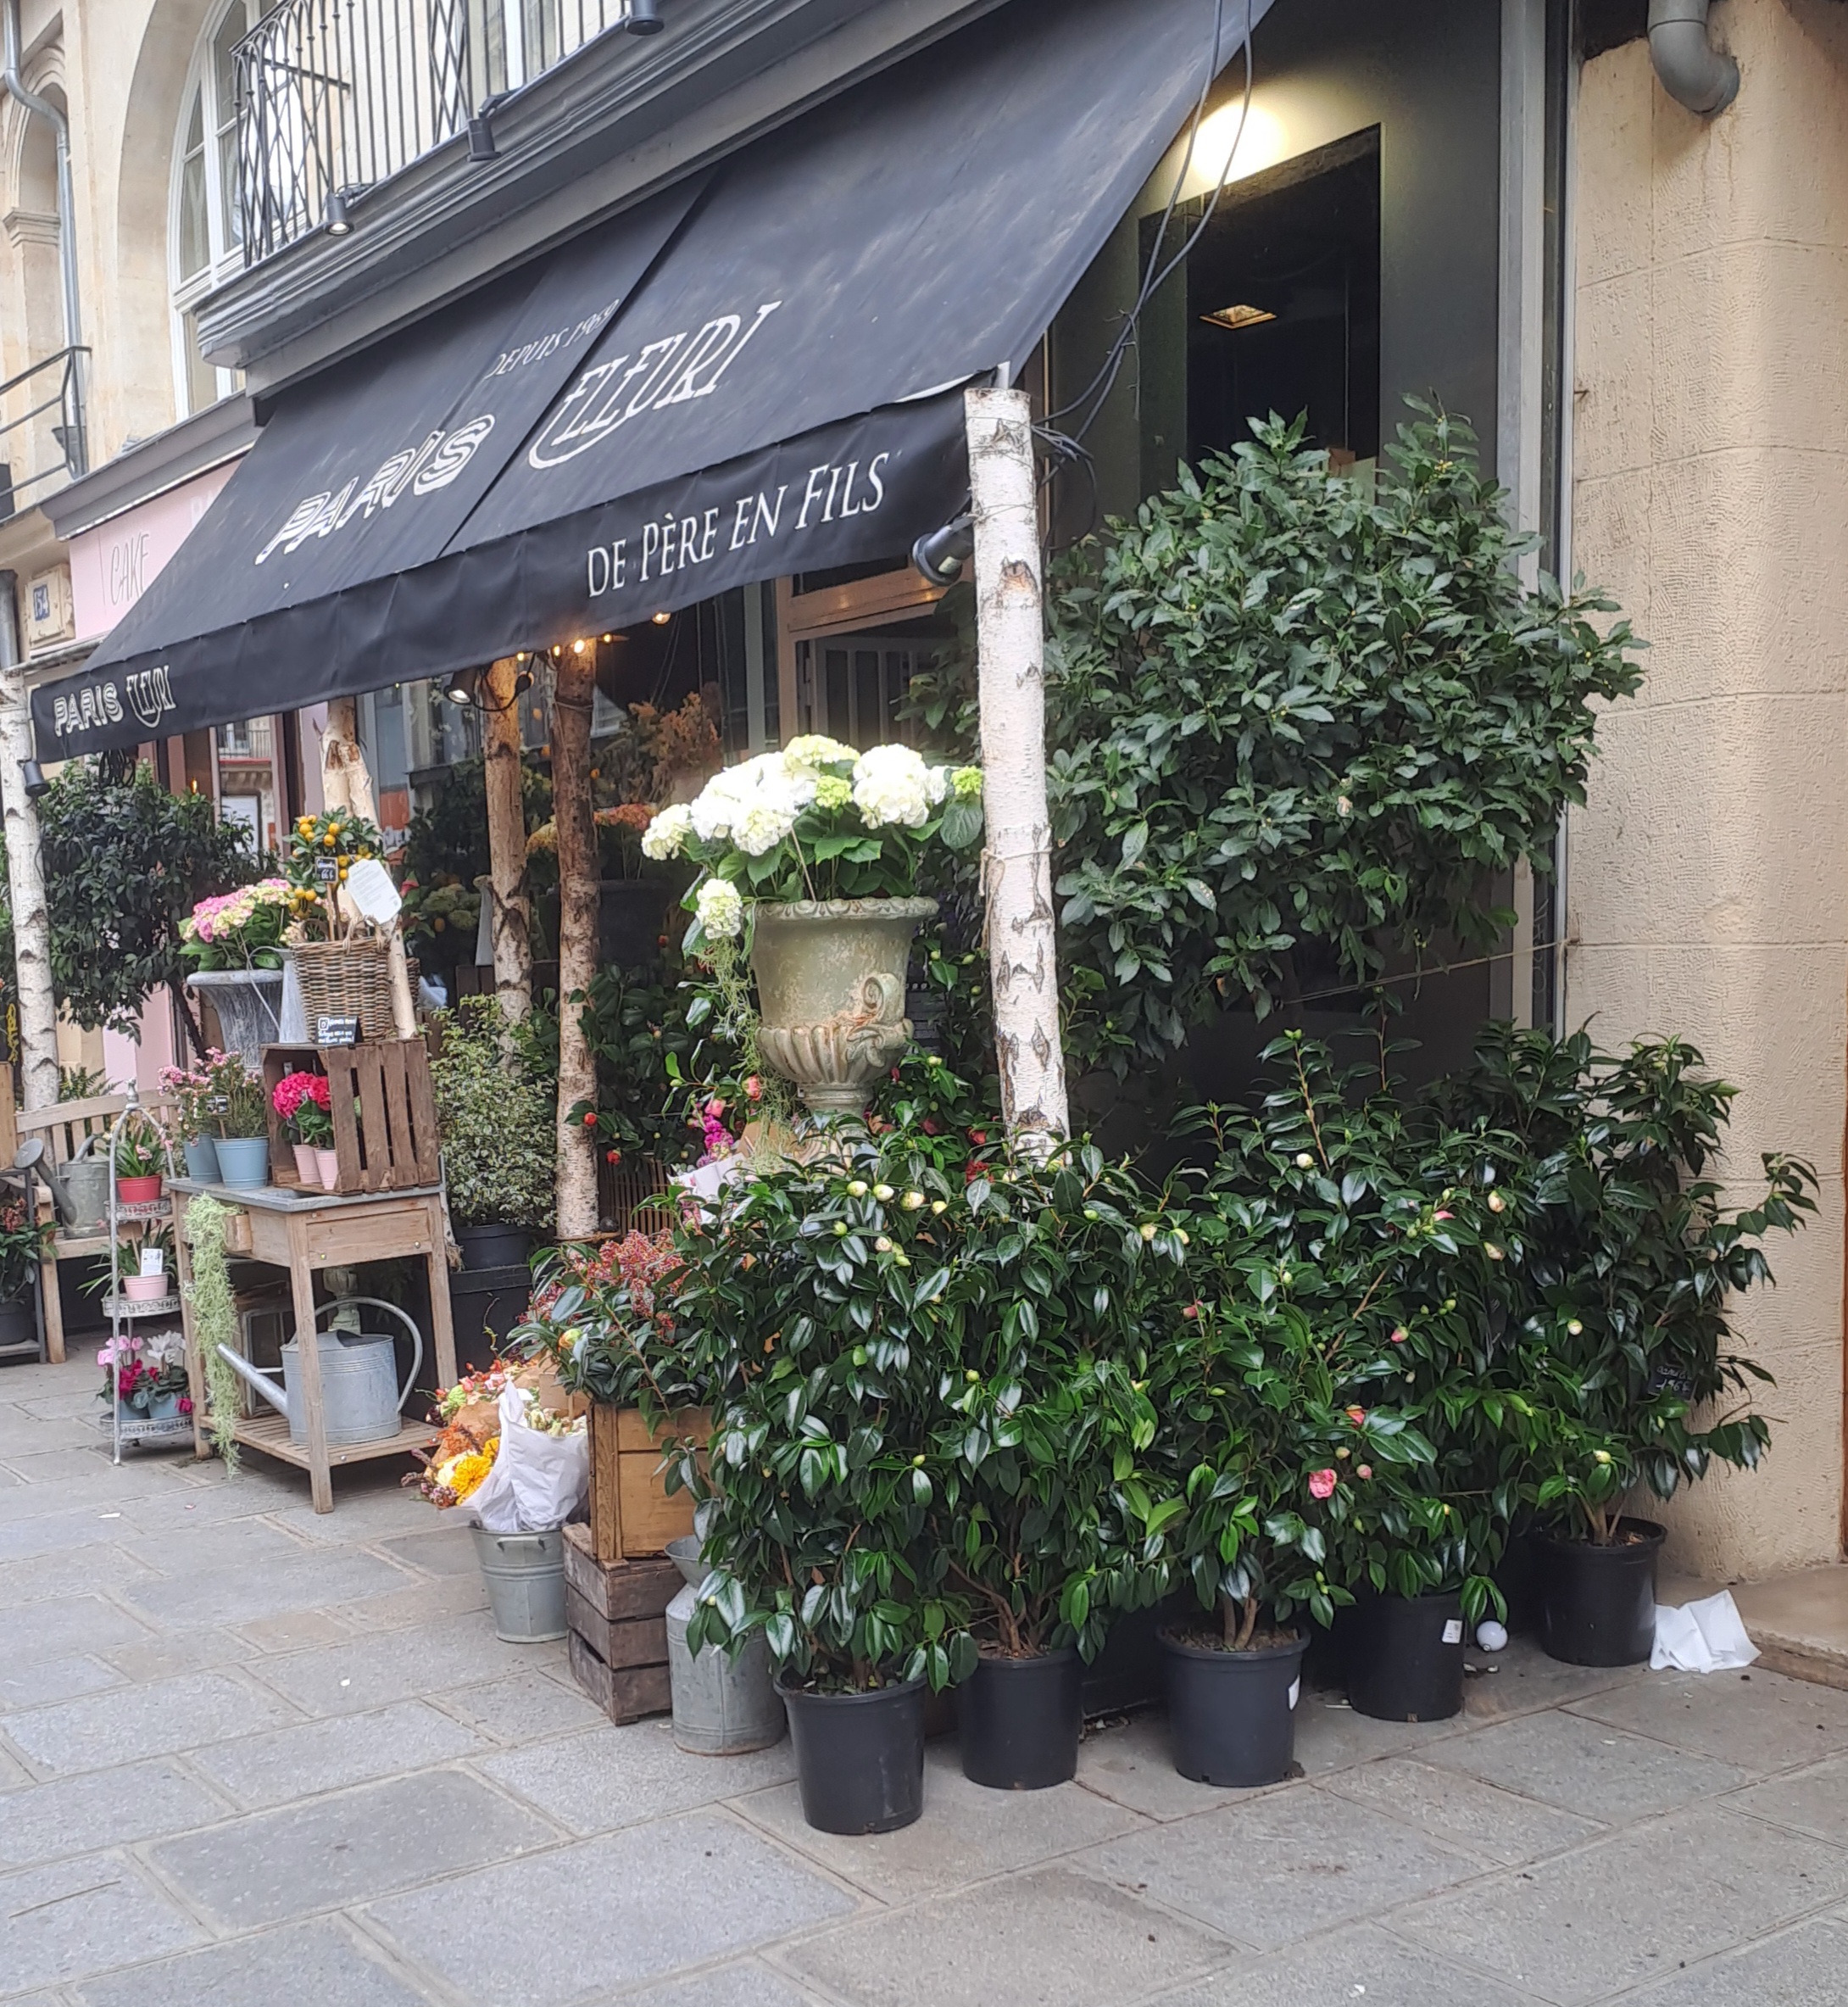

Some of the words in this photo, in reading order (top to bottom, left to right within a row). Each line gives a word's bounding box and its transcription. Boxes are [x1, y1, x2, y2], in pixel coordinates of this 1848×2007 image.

[484, 326, 570, 380] DEPUIS
[254, 414, 496, 565] PARIS
[529, 300, 782, 469] FLEURI
[587, 539, 626, 598] DE
[639, 512, 720, 583] PÈRE
[728, 485, 788, 551] EN
[794, 452, 889, 530] FILS
[53, 682, 124, 737] PARIS
[126, 665, 176, 728] FLEURI
